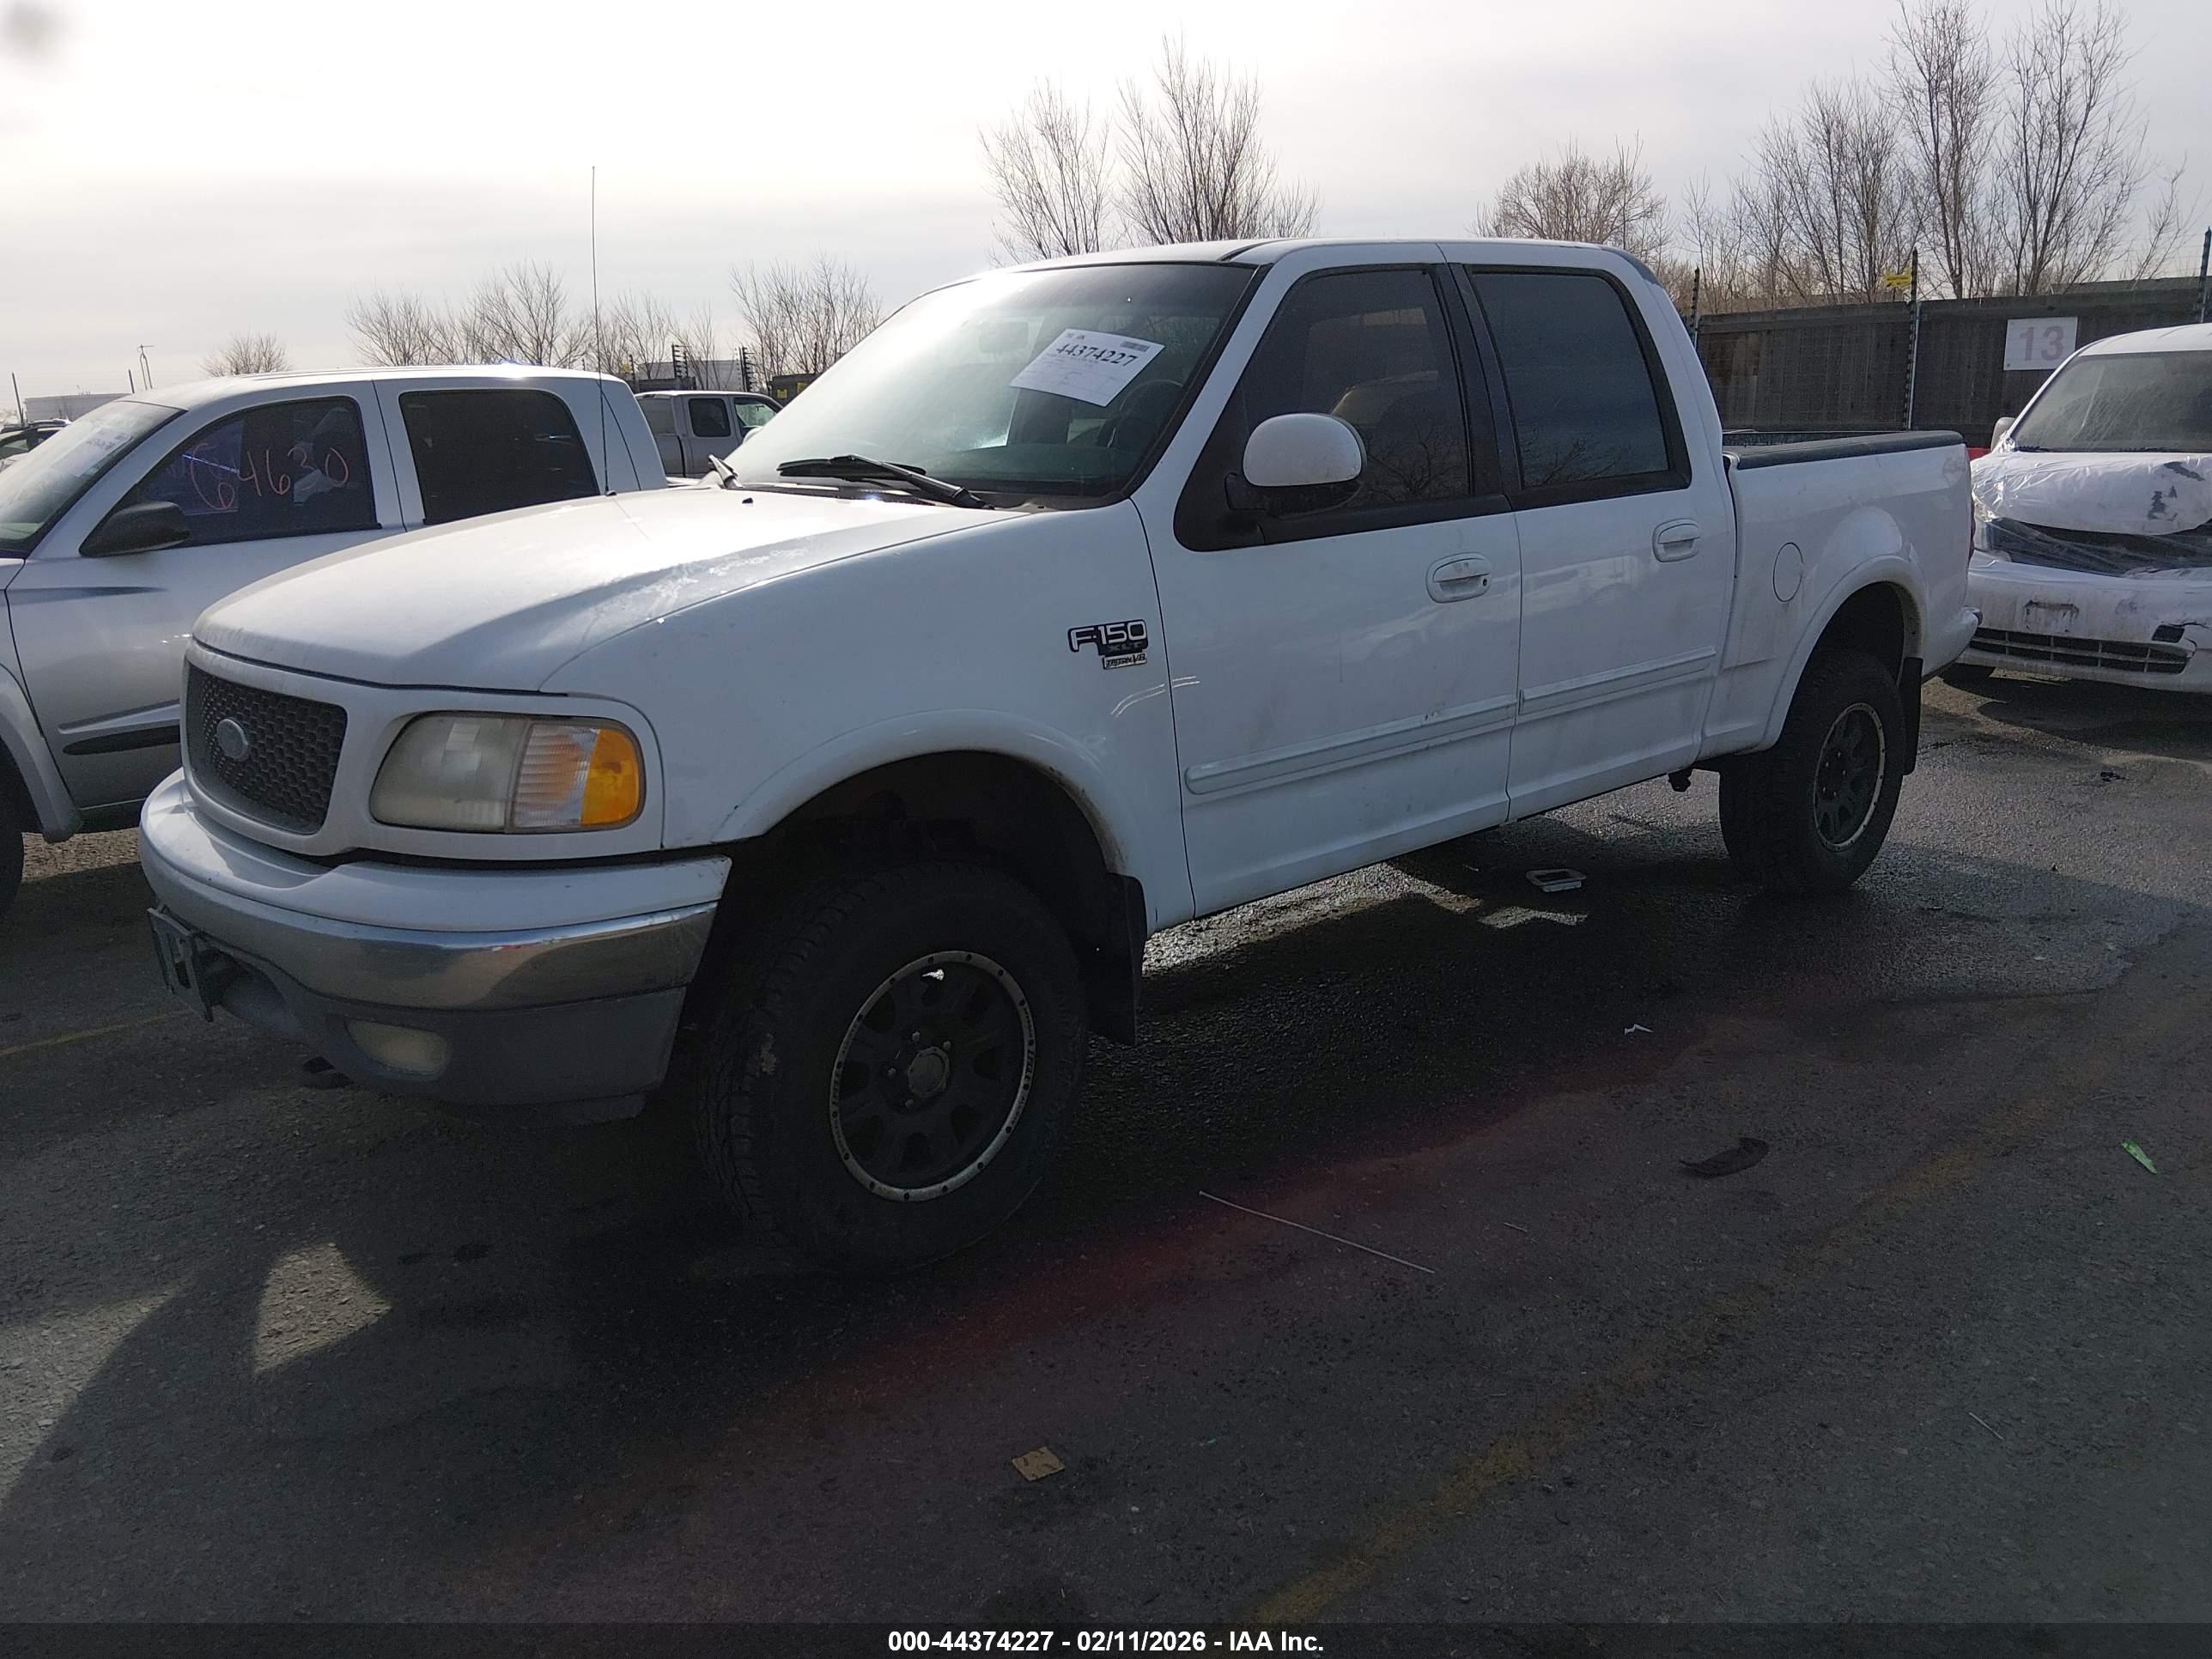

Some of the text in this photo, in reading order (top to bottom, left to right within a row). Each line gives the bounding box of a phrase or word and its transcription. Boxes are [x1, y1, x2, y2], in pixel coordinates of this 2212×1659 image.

[1055, 343, 1139, 367] 44374227
[2019, 326, 2064, 362] 13
[190, 442, 349, 510] 64630
[1108, 641, 1143, 652] XLT
